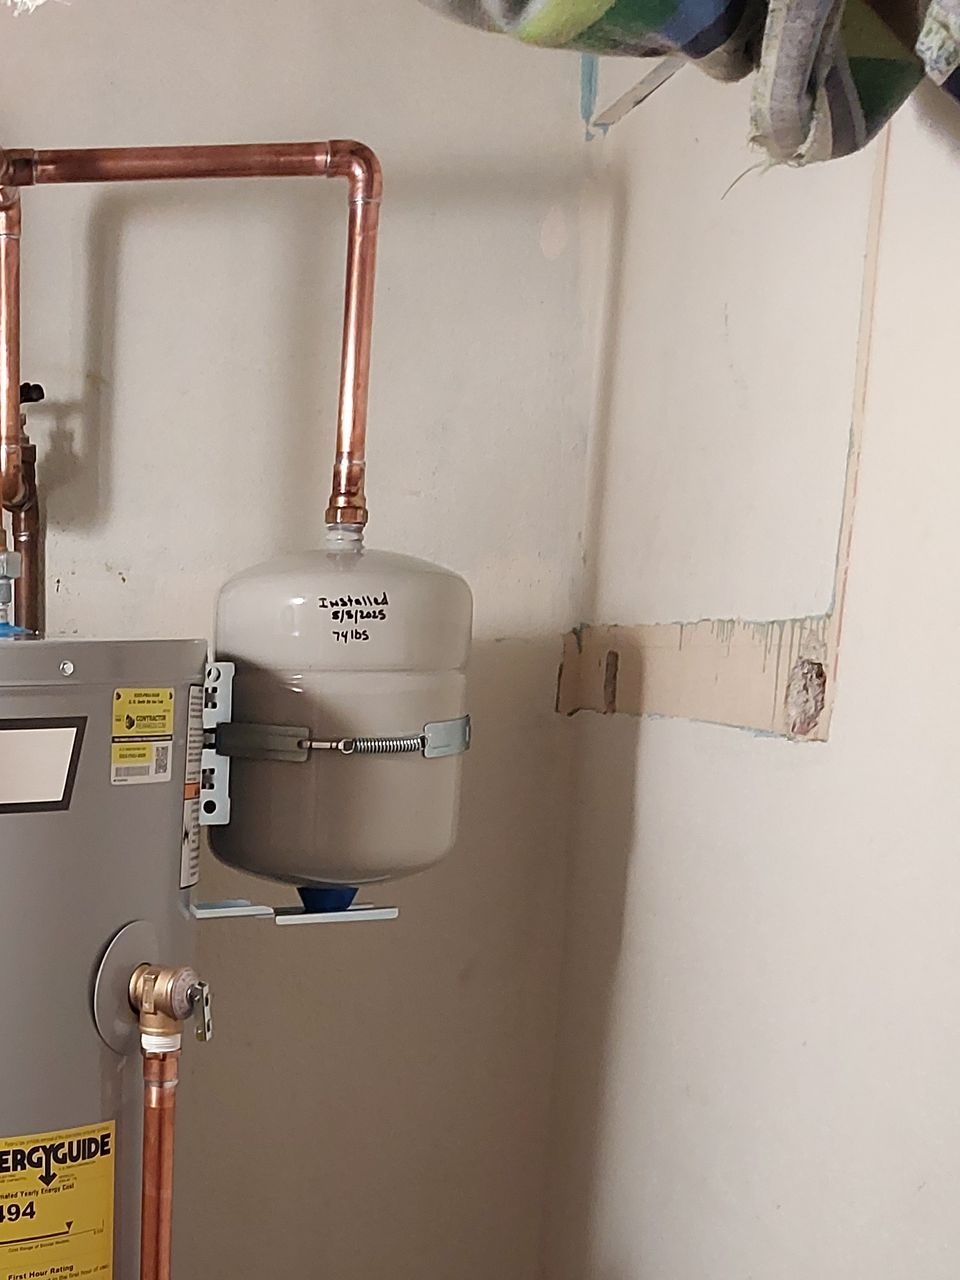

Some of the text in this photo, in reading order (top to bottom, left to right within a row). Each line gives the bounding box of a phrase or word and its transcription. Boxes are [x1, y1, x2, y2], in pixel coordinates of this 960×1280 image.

[20, 1189, 39, 1198] Yearly
[41, 1185, 61, 1194] Energy
[62, 1182, 74, 1191] Cost
[29, 1270, 48, 1278] Hour
[50, 1265, 74, 1274] Rating
